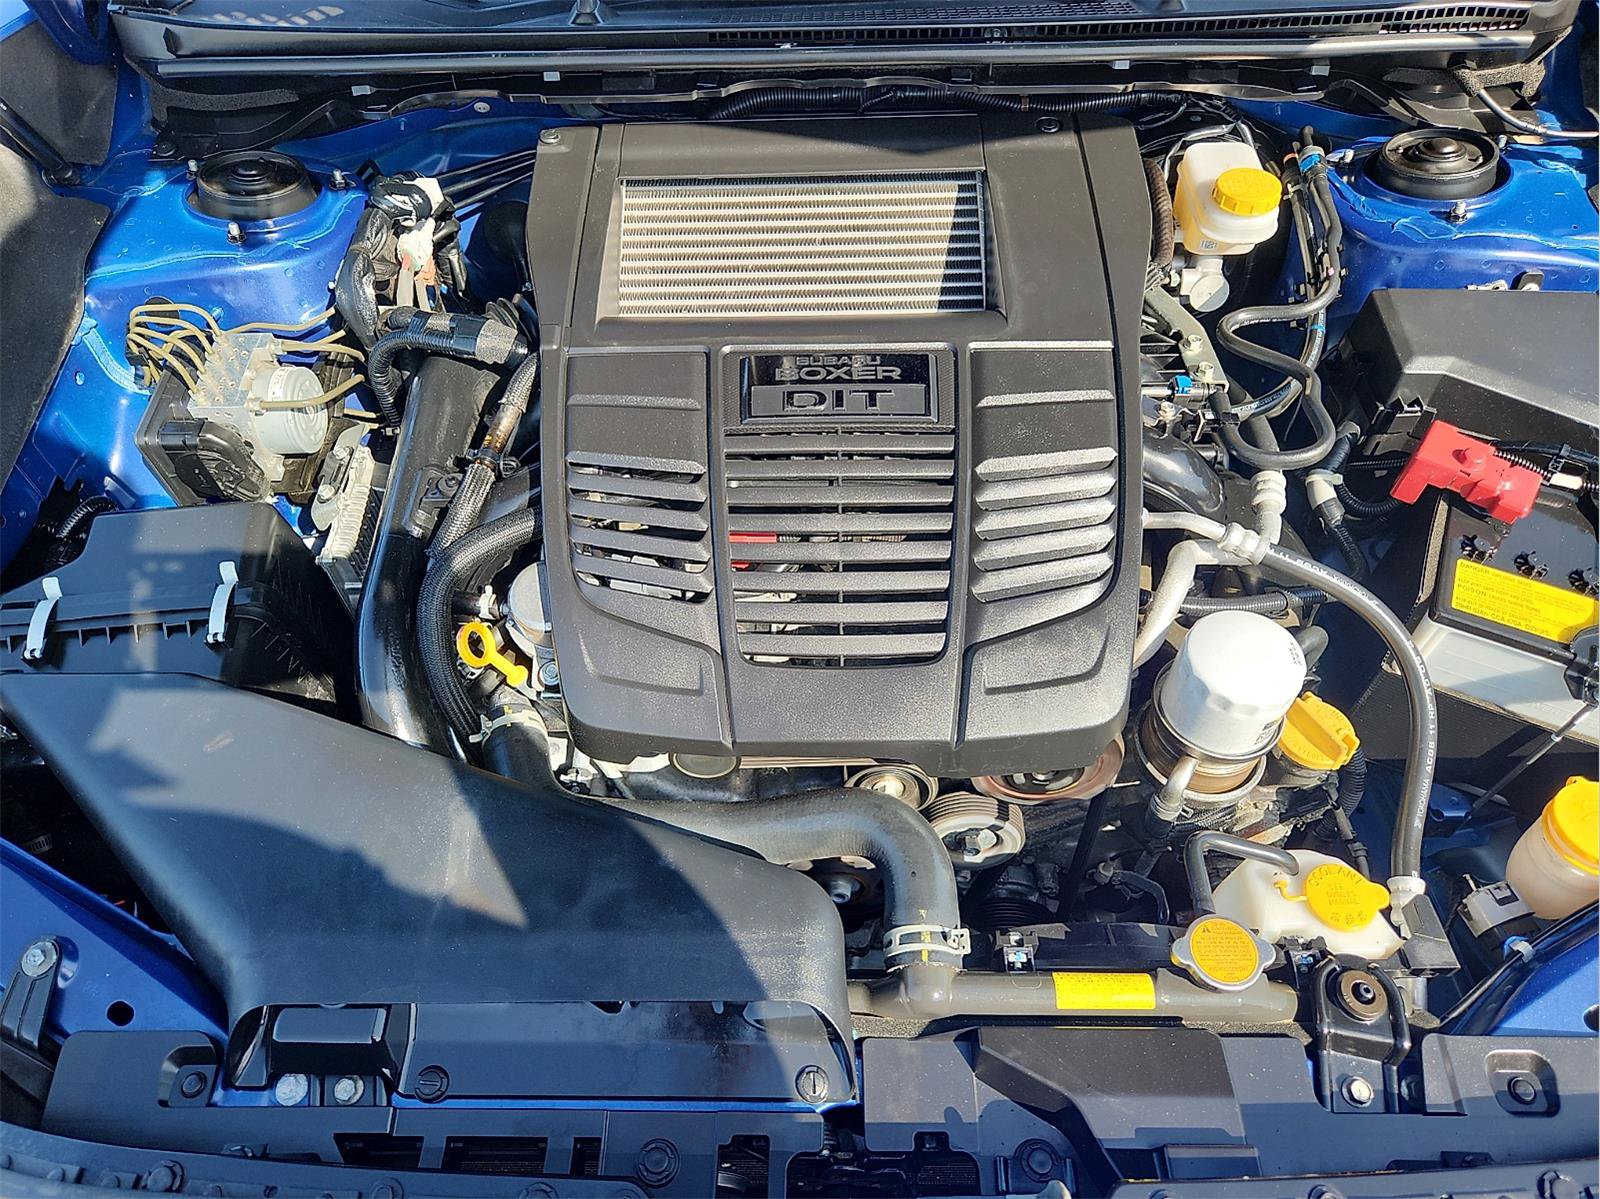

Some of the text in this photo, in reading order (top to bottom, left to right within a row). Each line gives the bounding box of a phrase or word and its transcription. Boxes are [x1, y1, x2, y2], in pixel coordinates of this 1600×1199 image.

[796, 356, 881, 367] SUBARU
[775, 366, 902, 381] BOXER
[782, 389, 895, 412] DIT
[1459, 562, 1490, 575] DANGER
[1457, 583, 1487, 597] POISON
[1308, 863, 1365, 888] COOLANT
